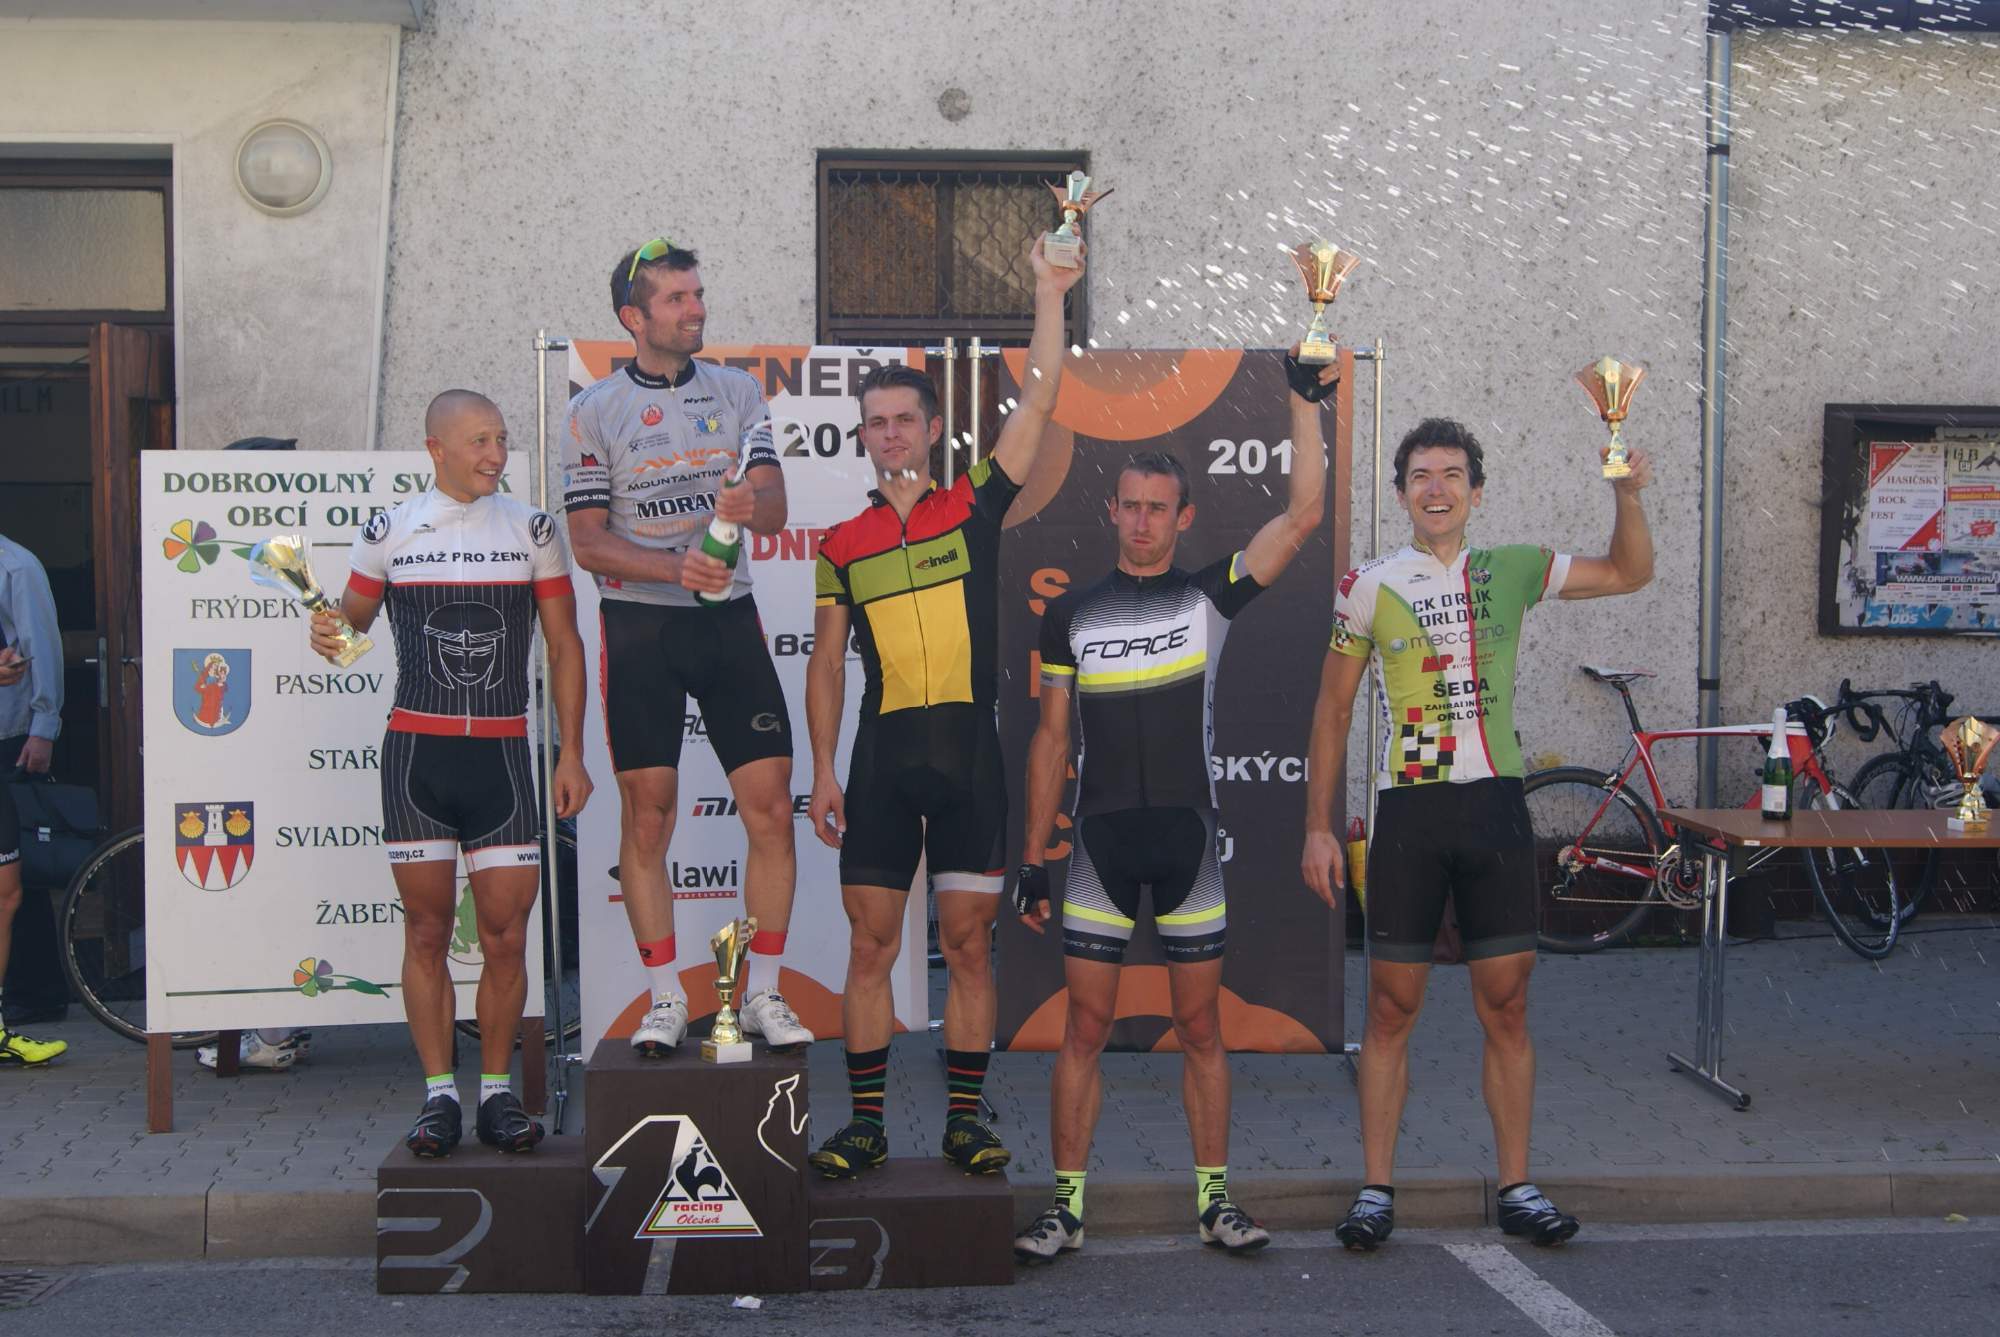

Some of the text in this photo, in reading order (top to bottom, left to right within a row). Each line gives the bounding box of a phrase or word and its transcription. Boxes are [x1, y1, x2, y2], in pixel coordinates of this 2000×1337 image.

[1207, 438, 1329, 475] 201
[163, 467, 376, 494] DOBROVOLNÝ
[1878, 495, 1907, 505] ROCK
[227, 500, 308, 527] OBCÍ
[1870, 511, 1896, 521] FEST
[392, 550, 530, 567] MASÁŽ PRO ŽENY
[1412, 588, 1493, 614] CK ORLÍK
[1418, 604, 1491, 628] ORLOVÁ
[1081, 626, 1189, 662] FORCE
[274, 673, 385, 695] PASKOV
[1433, 677, 1490, 698] ŠEDA
[1210, 750, 1309, 782] SKÝC
[275, 825, 388, 848] SVIADN
[673, 1202, 723, 1213] racing
